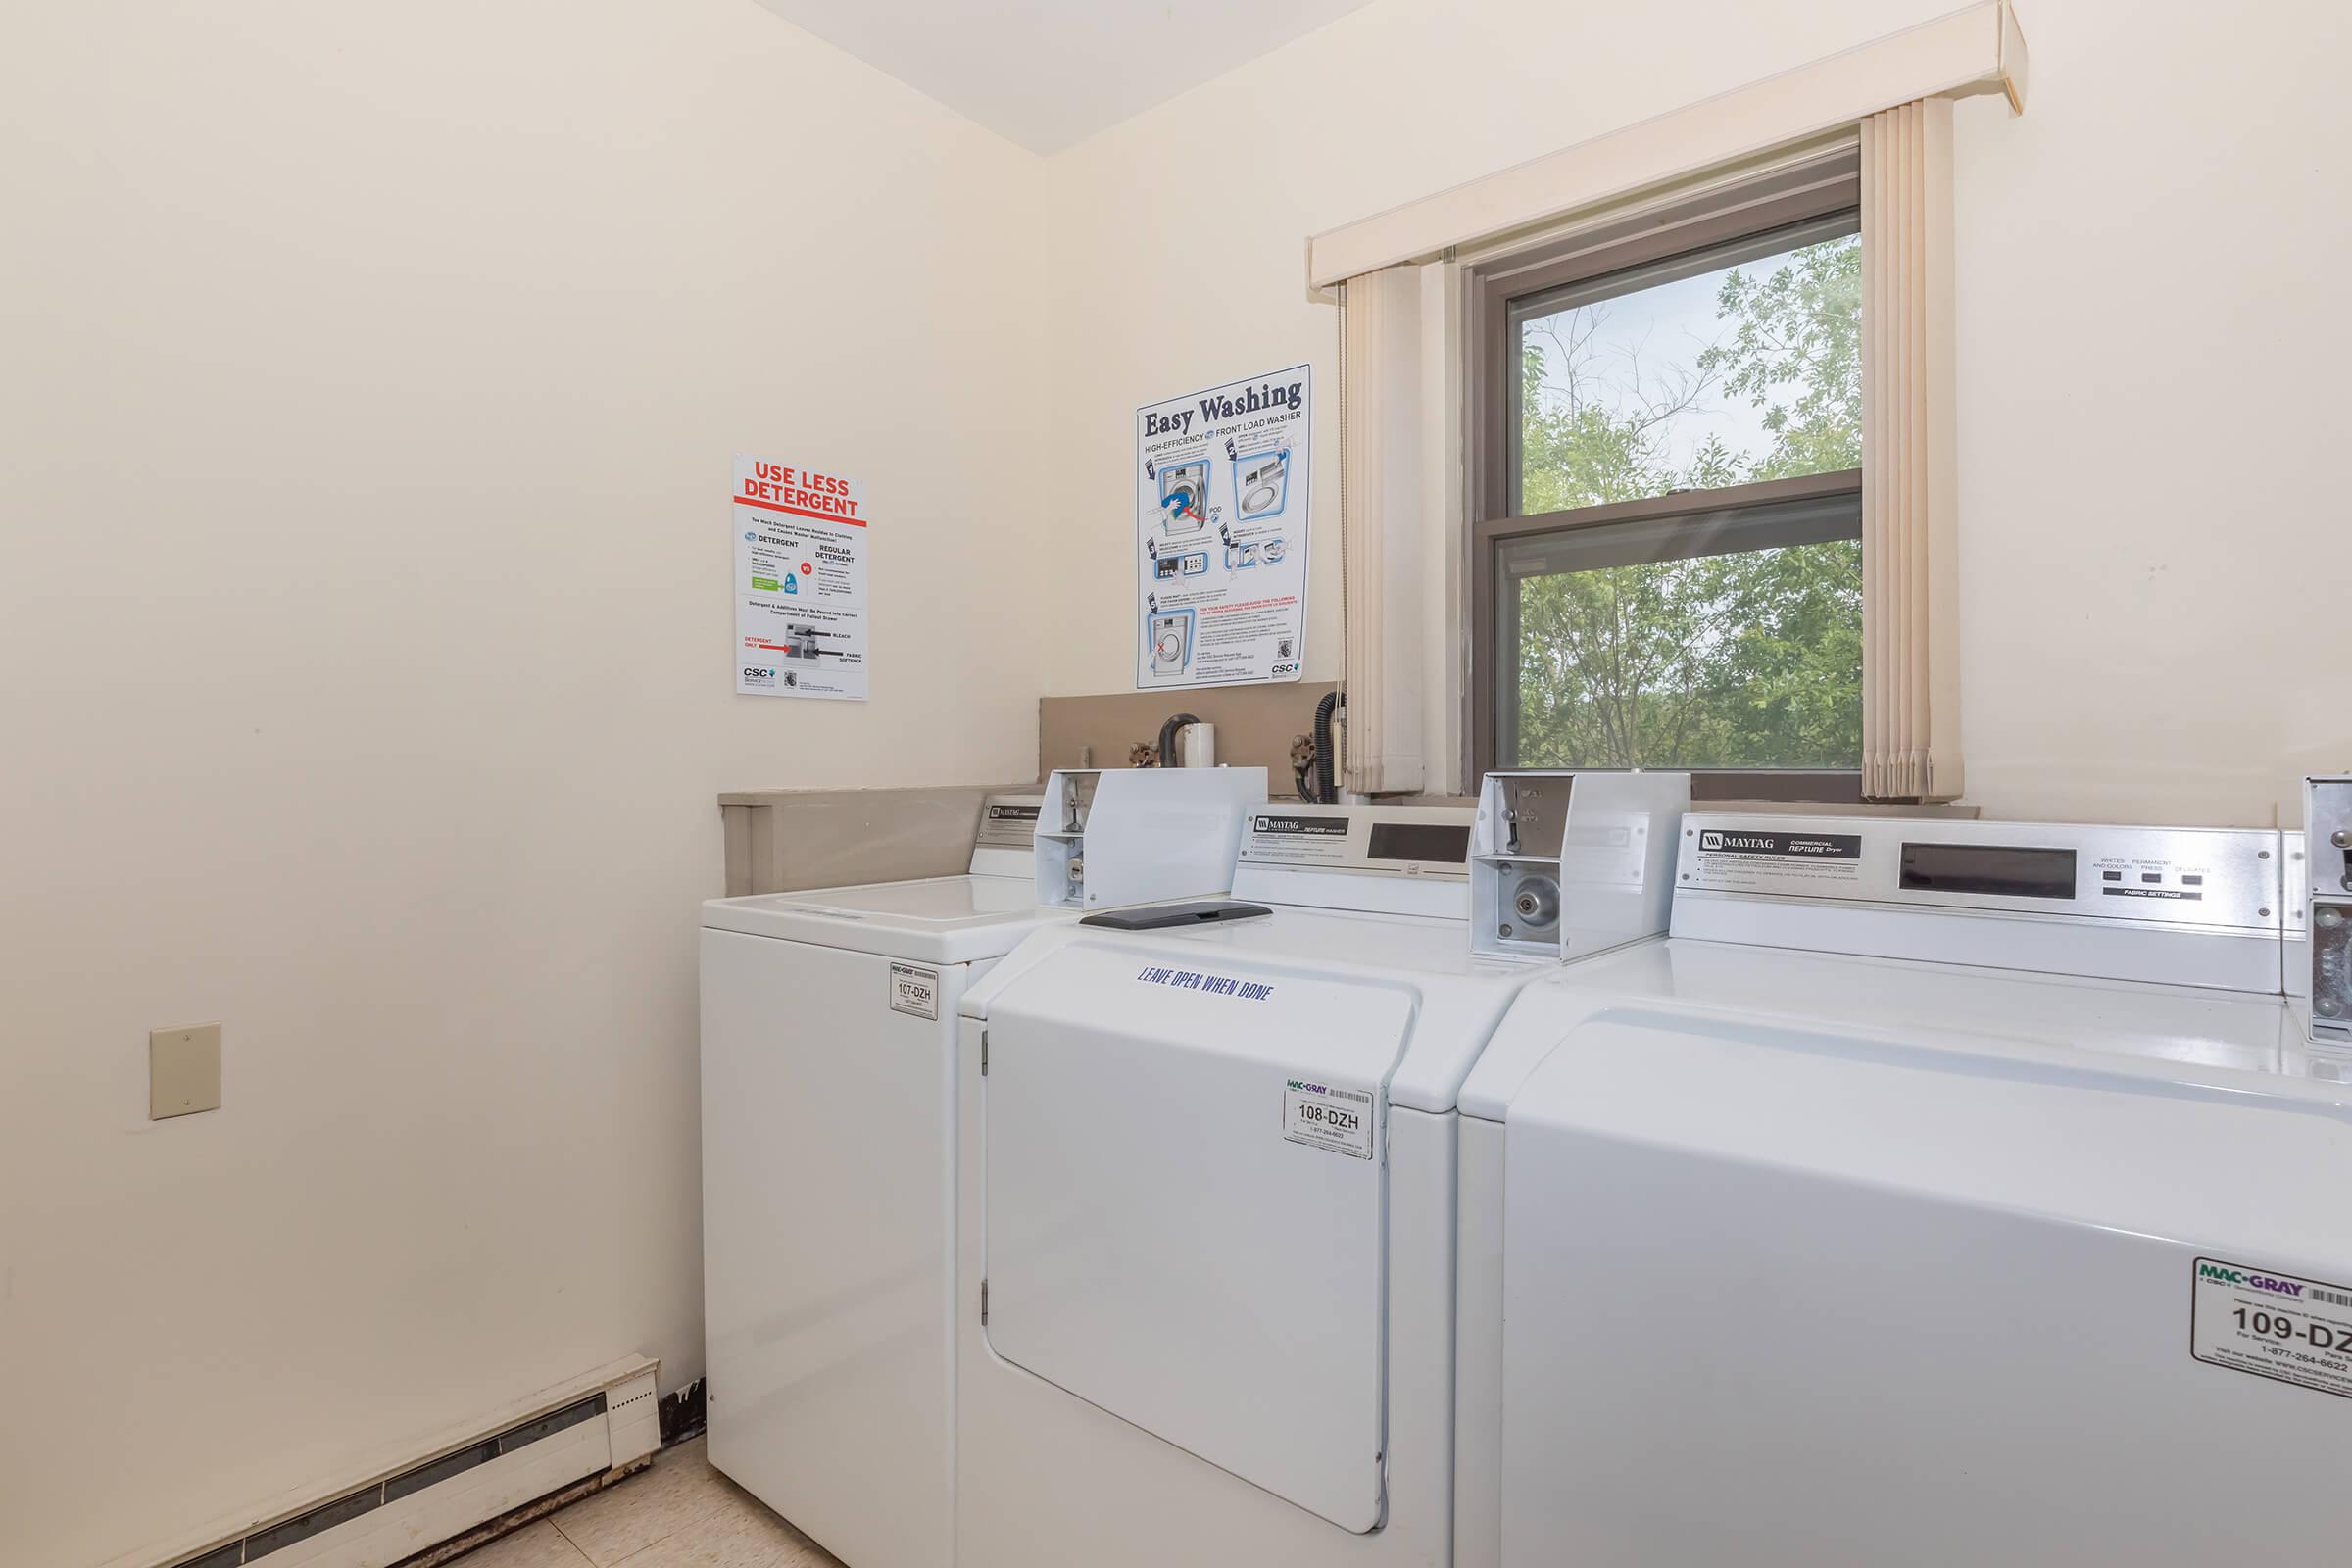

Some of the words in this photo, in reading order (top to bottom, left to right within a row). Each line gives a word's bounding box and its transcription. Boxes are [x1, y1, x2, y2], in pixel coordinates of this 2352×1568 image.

[1145, 410, 1195, 437] Easy
[1200, 383, 1302, 422] Washing
[1145, 433, 1204, 454] HIGH-EFFICIENCY
[1216, 424, 1242, 438] FRONT
[1244, 419, 1265, 431] LOAD
[1267, 411, 1301, 425] WASHER
[1229, 446, 1236, 456] 2
[755, 461, 796, 486] USE
[802, 471, 849, 497] LESS
[744, 478, 858, 516] DETERGENT
[773, 521, 796, 530] Detergent
[759, 535, 799, 548] DETERGENT
[819, 545, 851, 556] REGULAR
[1150, 546, 1155, 555] 3
[815, 552, 855, 564] DETERGENT
[1152, 600, 1156, 609] 5
[770, 610, 801, 618] Compartment
[744, 668, 768, 678] CSC
[1272, 664, 1294, 673] CSC
[1269, 821, 1299, 830] MAYTAG
[1724, 837, 1774, 849] MAYTAG
[1137, 967, 1174, 985] LEAVE
[1171, 971, 1204, 990] OPEN
[1201, 975, 1240, 996] WHEN
[1238, 982, 1274, 1001] DONE
[899, 983, 931, 1001] 107-DZH
[1299, 1104, 1359, 1130] 108-DZH
[2234, 1298, 2252, 1306] Please
[2278, 1307, 2301, 1317] machine
[2216, 1347, 2231, 1355] Visit
[2245, 1354, 2273, 1364] website
[2262, 1346, 2348, 1372] 1-877-264-6622
[2325, 1351, 2344, 1360] Para
